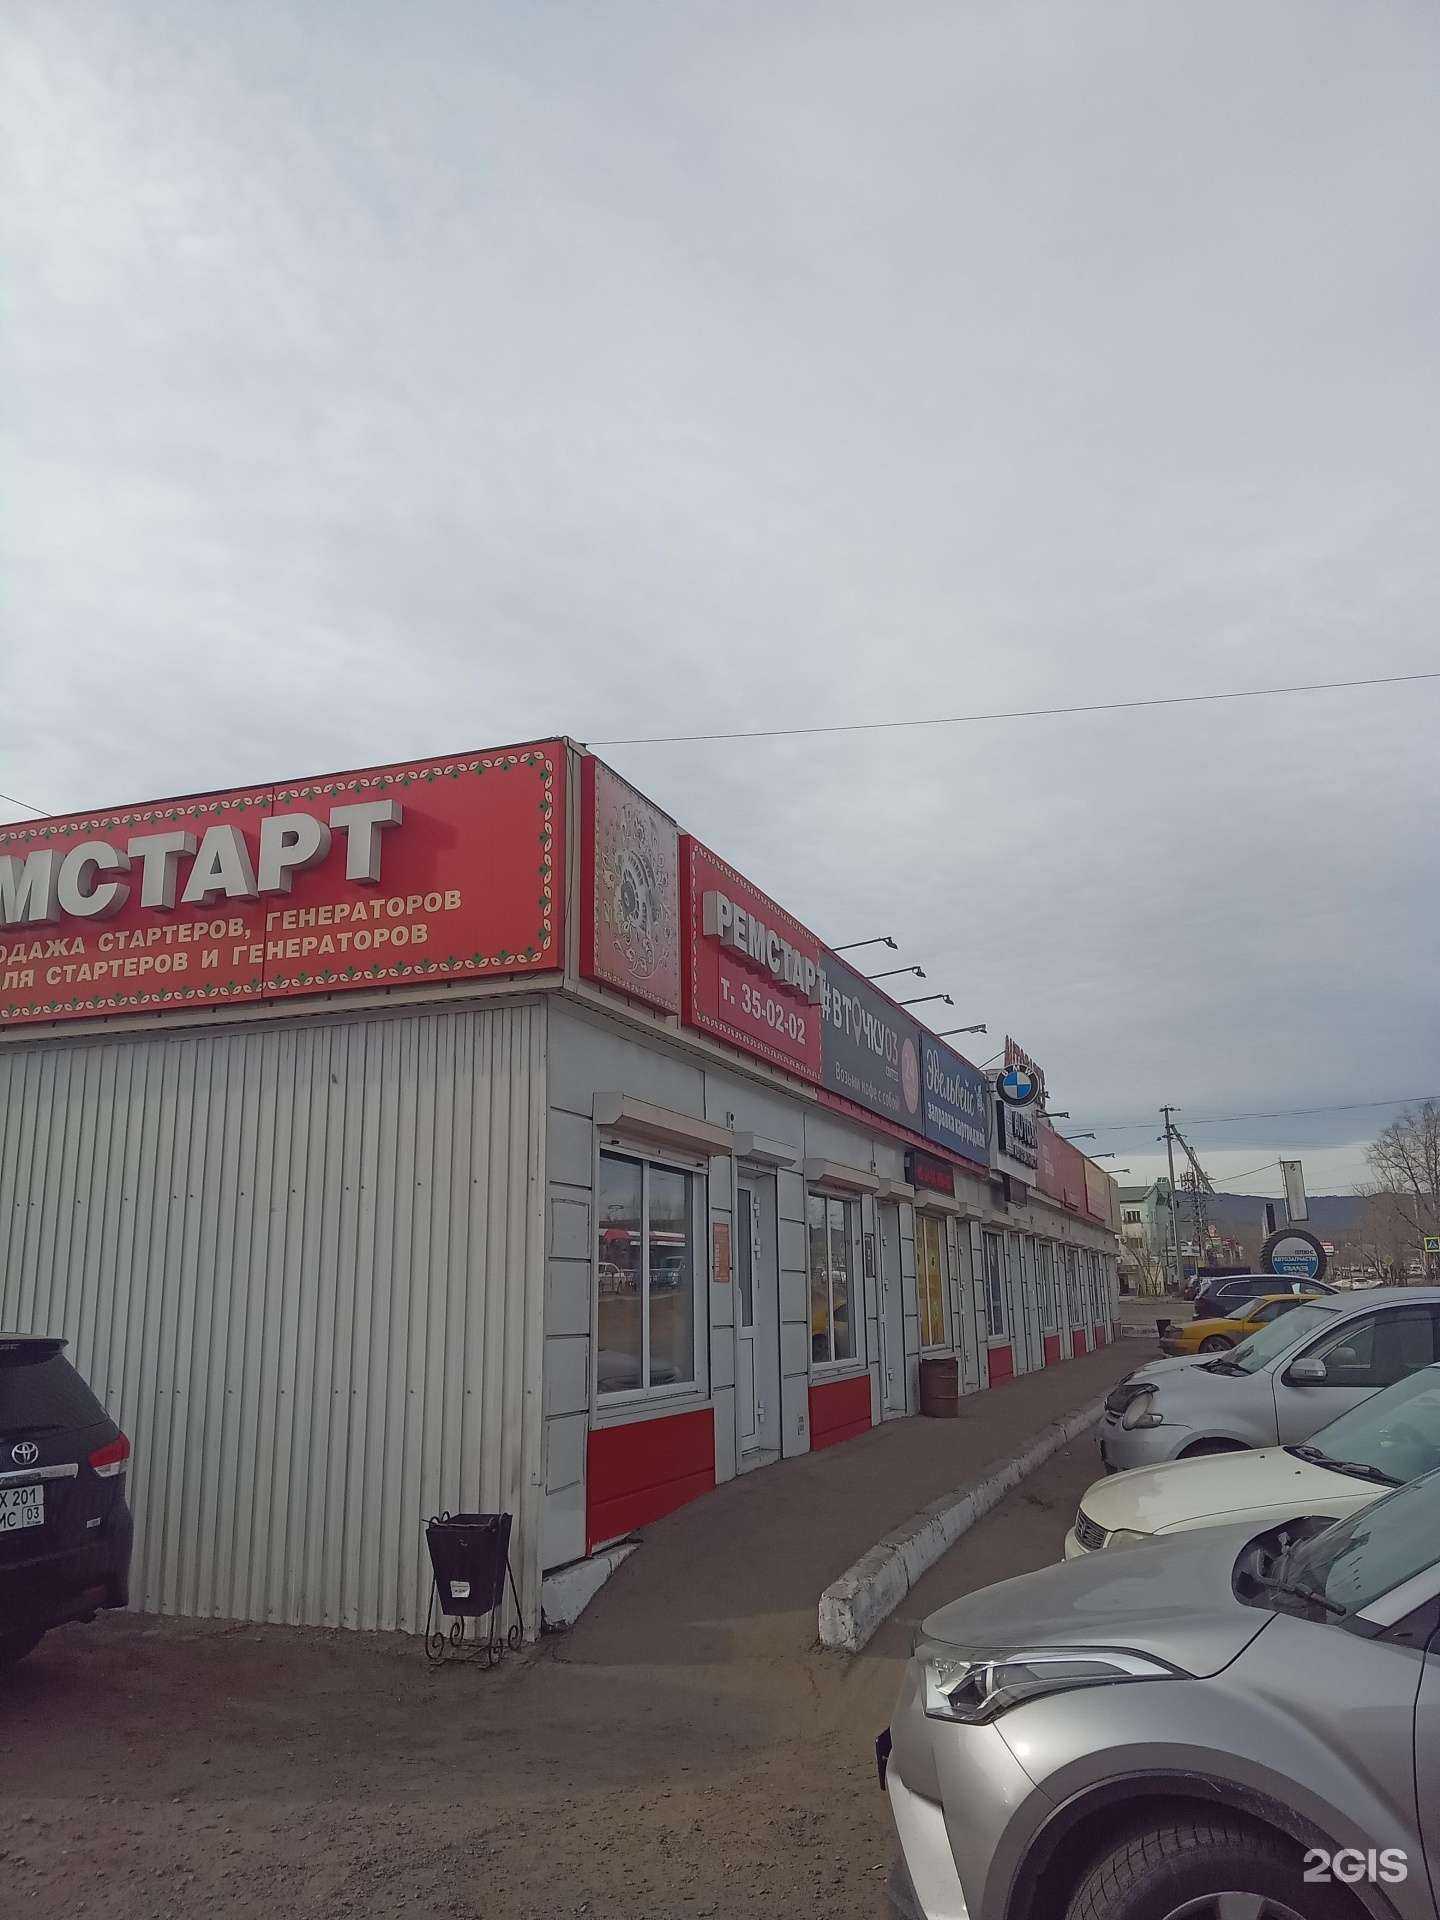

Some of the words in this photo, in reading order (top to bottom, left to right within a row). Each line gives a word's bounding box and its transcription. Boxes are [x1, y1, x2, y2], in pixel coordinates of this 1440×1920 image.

[98, 918, 251, 952] СТАРТЕРОВ,
[266, 890, 462, 932] ГЕНЕРАТОРОВ
[704, 892, 828, 1003] РЕМСТАРТ
[46, 952, 188, 985] СТАРТЕРОВ
[201, 949, 219, 969] И
[232, 924, 428, 966] ГЕНЕРАТОРОВ
[741, 983, 806, 1045] 35-02-02
[12, 1488, 37, 1507] 201
[26, 1506, 40, 1520] 03
